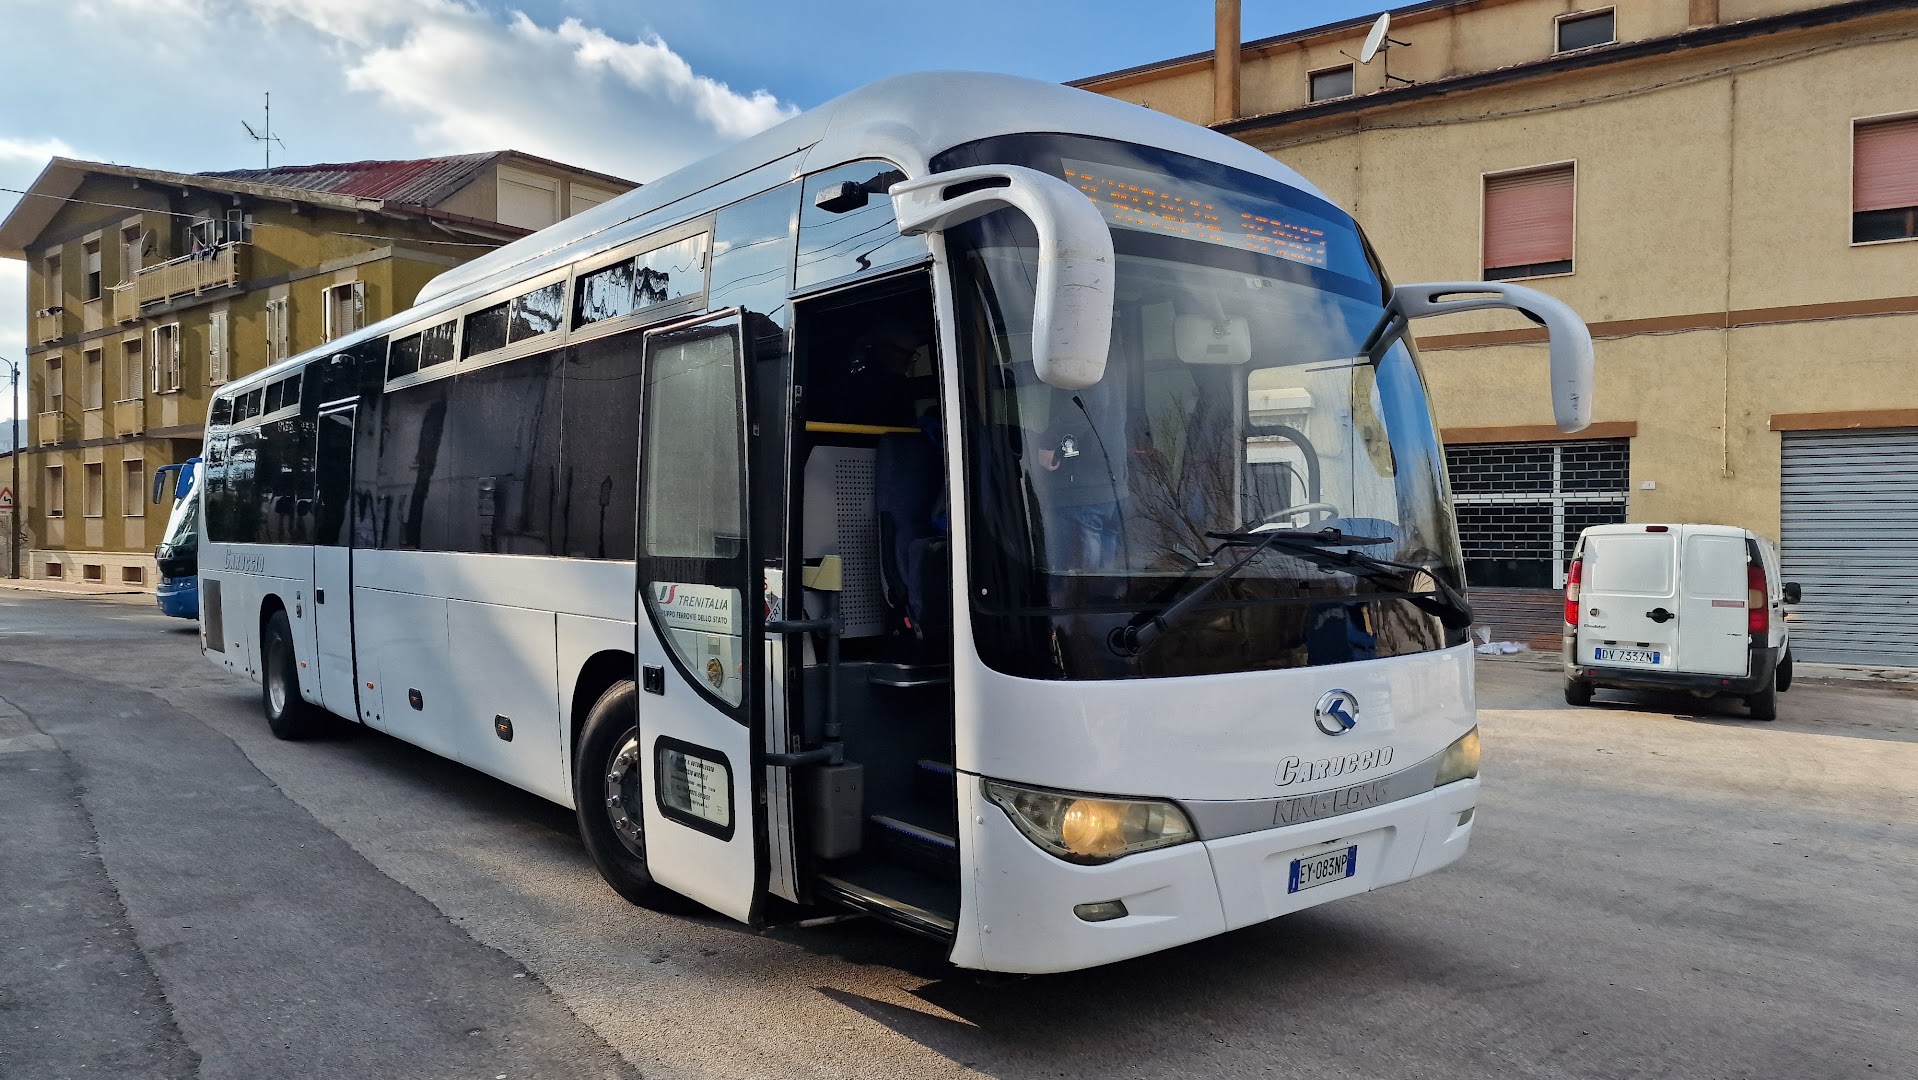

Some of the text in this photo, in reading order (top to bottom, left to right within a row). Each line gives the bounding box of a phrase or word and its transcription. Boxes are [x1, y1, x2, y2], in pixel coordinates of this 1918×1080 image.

[678, 594, 728, 611] TRENITALIA
[697, 613, 712, 623] DELLO
[712, 615, 728, 625] STATO
[1602, 649, 1653, 663] DV 733ZN
[1274, 746, 1393, 787] CARUCCIO
